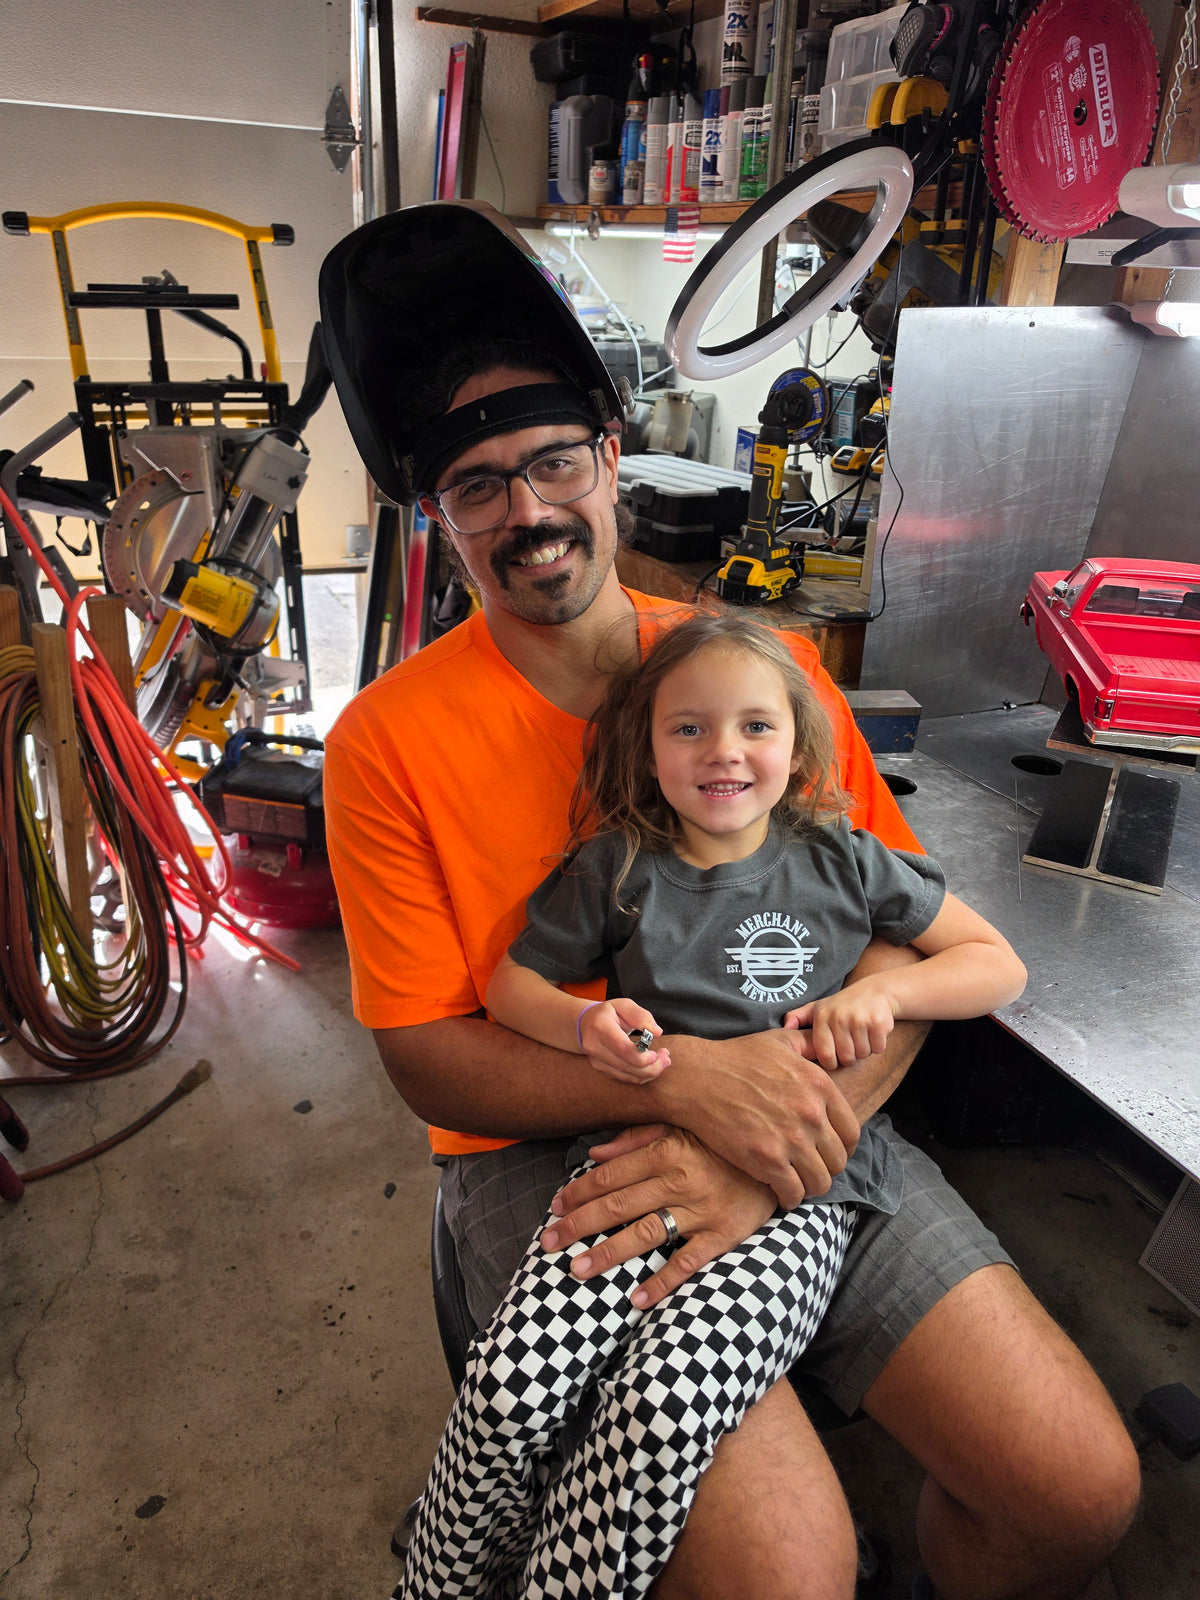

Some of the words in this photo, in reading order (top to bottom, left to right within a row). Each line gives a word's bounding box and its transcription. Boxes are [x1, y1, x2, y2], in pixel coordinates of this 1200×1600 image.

[727, 12, 750, 29] 2X
[1093, 47, 1112, 121] DIABLO
[1056, 86, 1067, 123] General
[1063, 124, 1072, 162] Purpose
[705, 130, 722, 146] 2X
[734, 911, 811, 941] MERCHANT
[726, 964, 741, 974] EST.
[739, 979, 784, 1003] METAL
[783, 977, 808, 1000] FAB
